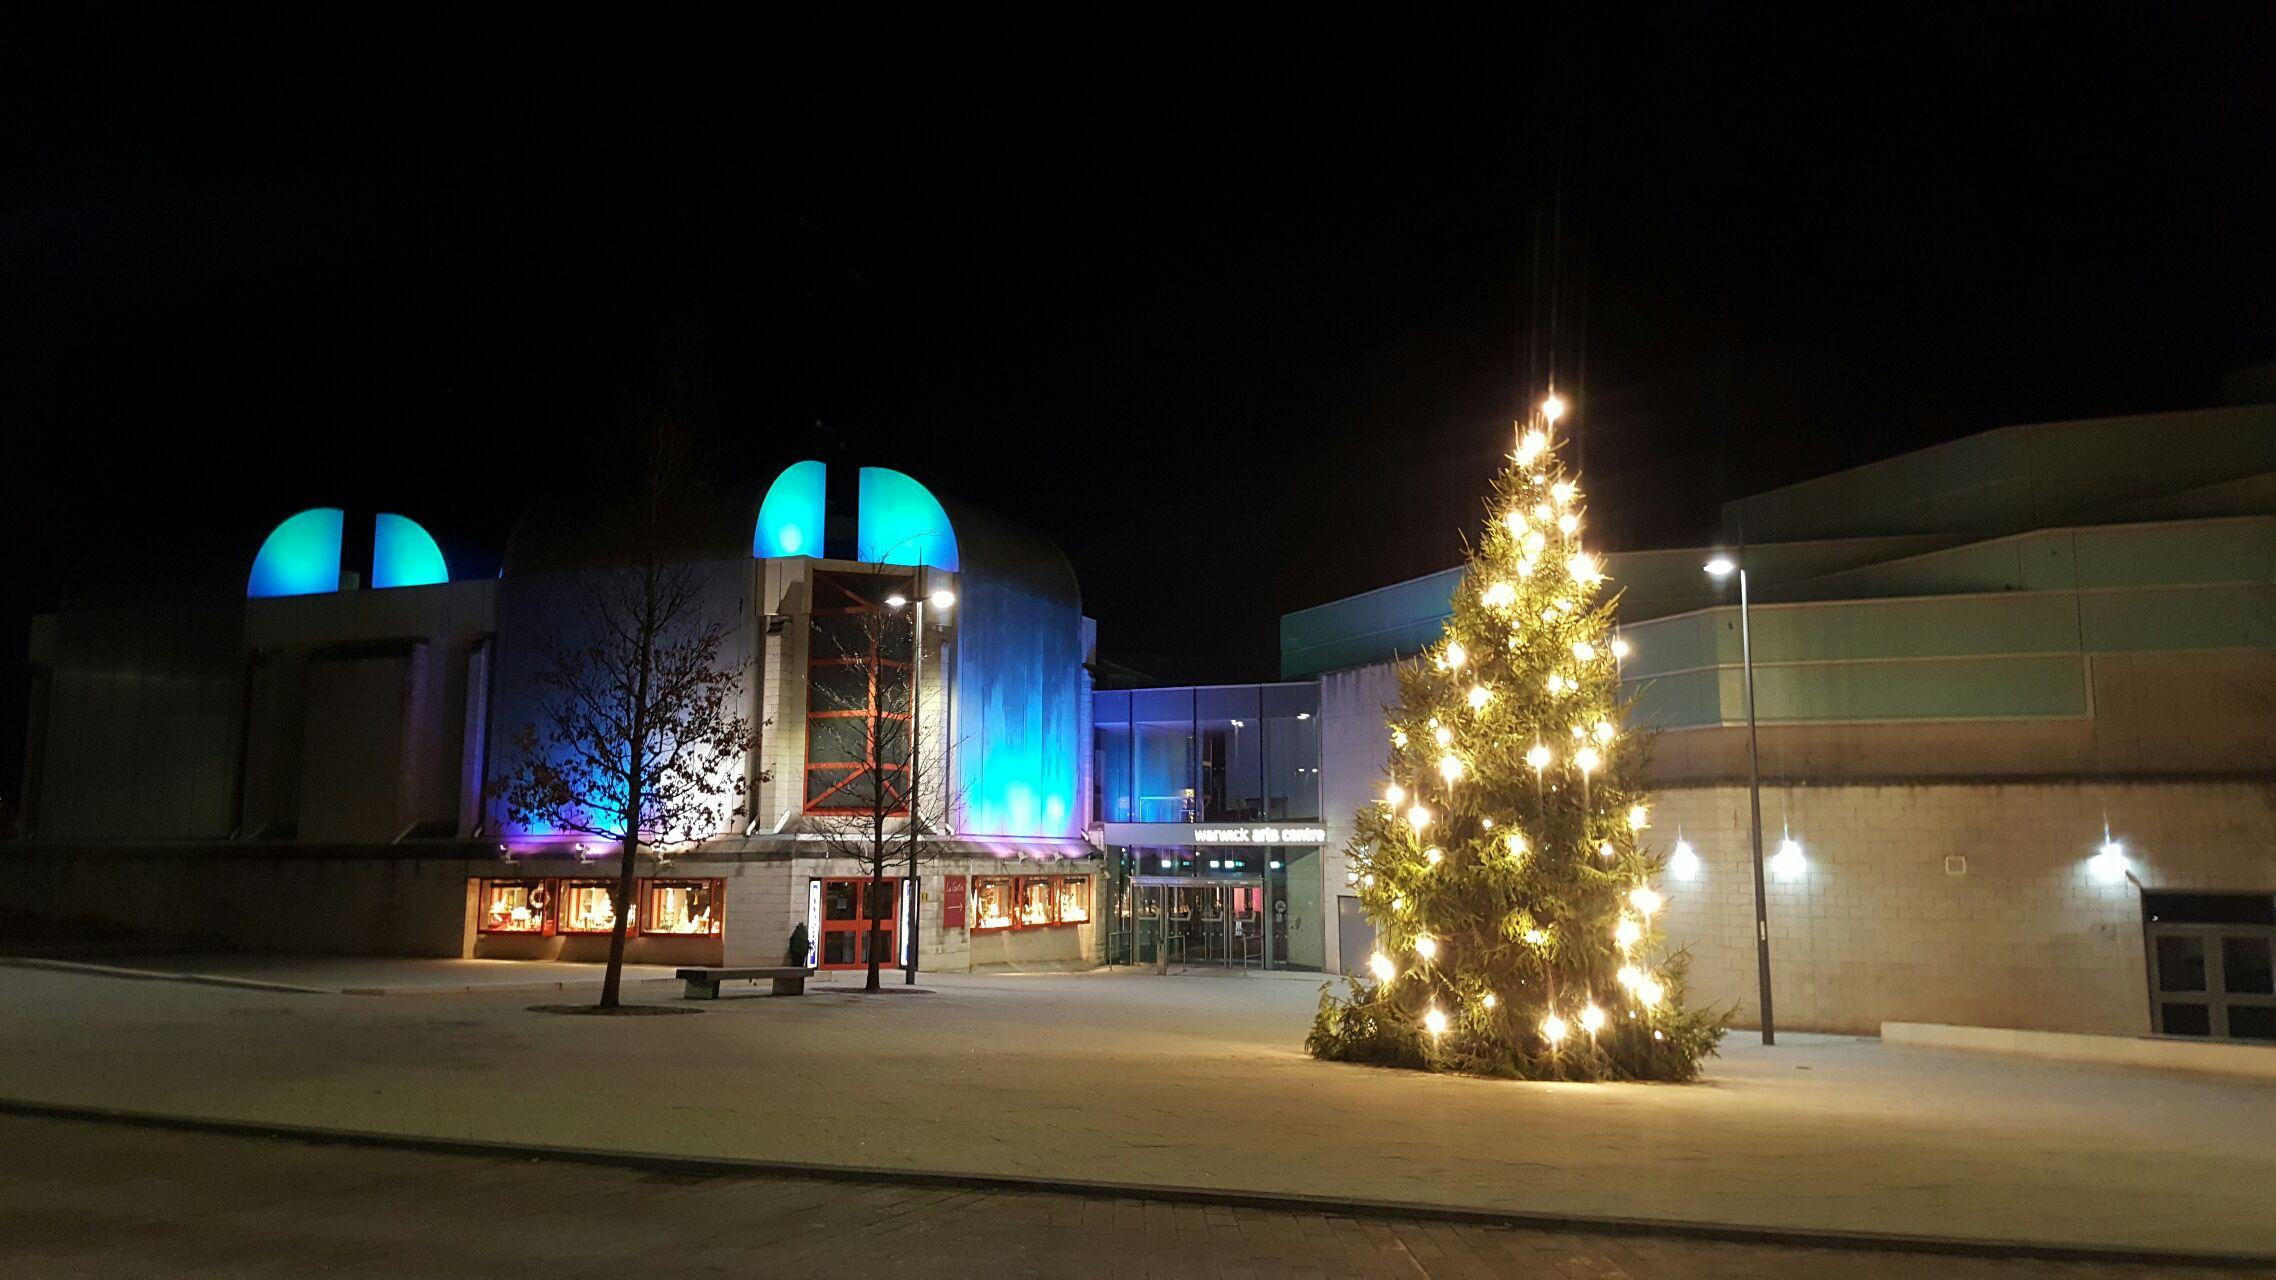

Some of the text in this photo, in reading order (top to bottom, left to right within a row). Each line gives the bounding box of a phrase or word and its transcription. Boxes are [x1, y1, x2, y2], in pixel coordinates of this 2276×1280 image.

[1194, 827, 1325, 843] warwick arts centre
